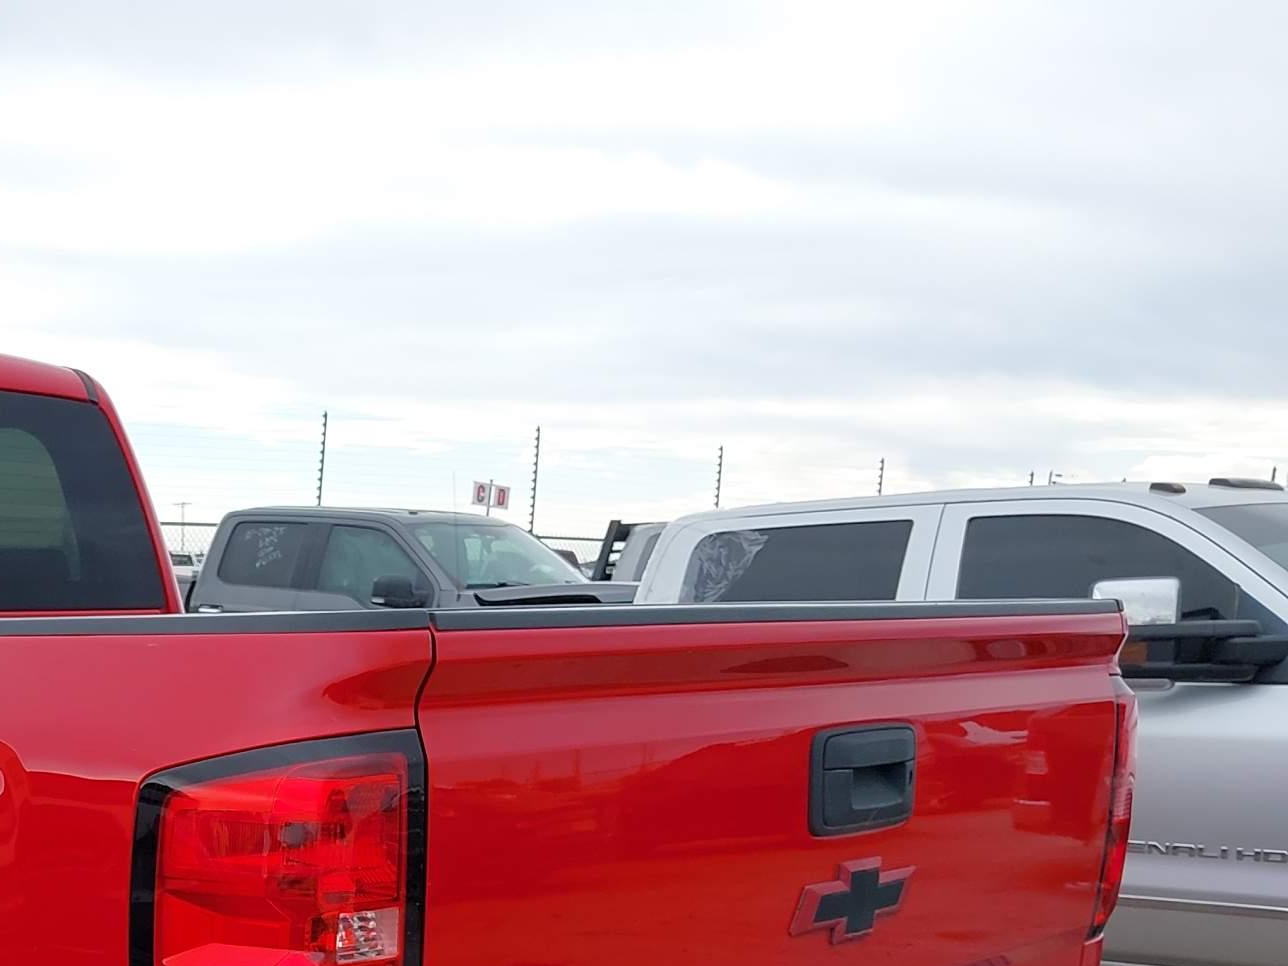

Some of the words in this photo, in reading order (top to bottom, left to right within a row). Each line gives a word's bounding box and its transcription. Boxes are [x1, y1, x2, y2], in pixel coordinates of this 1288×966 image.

[477, 484, 485, 503] C
[498, 488, 506, 506] D
[1128, 839, 1228, 860] ENALI
